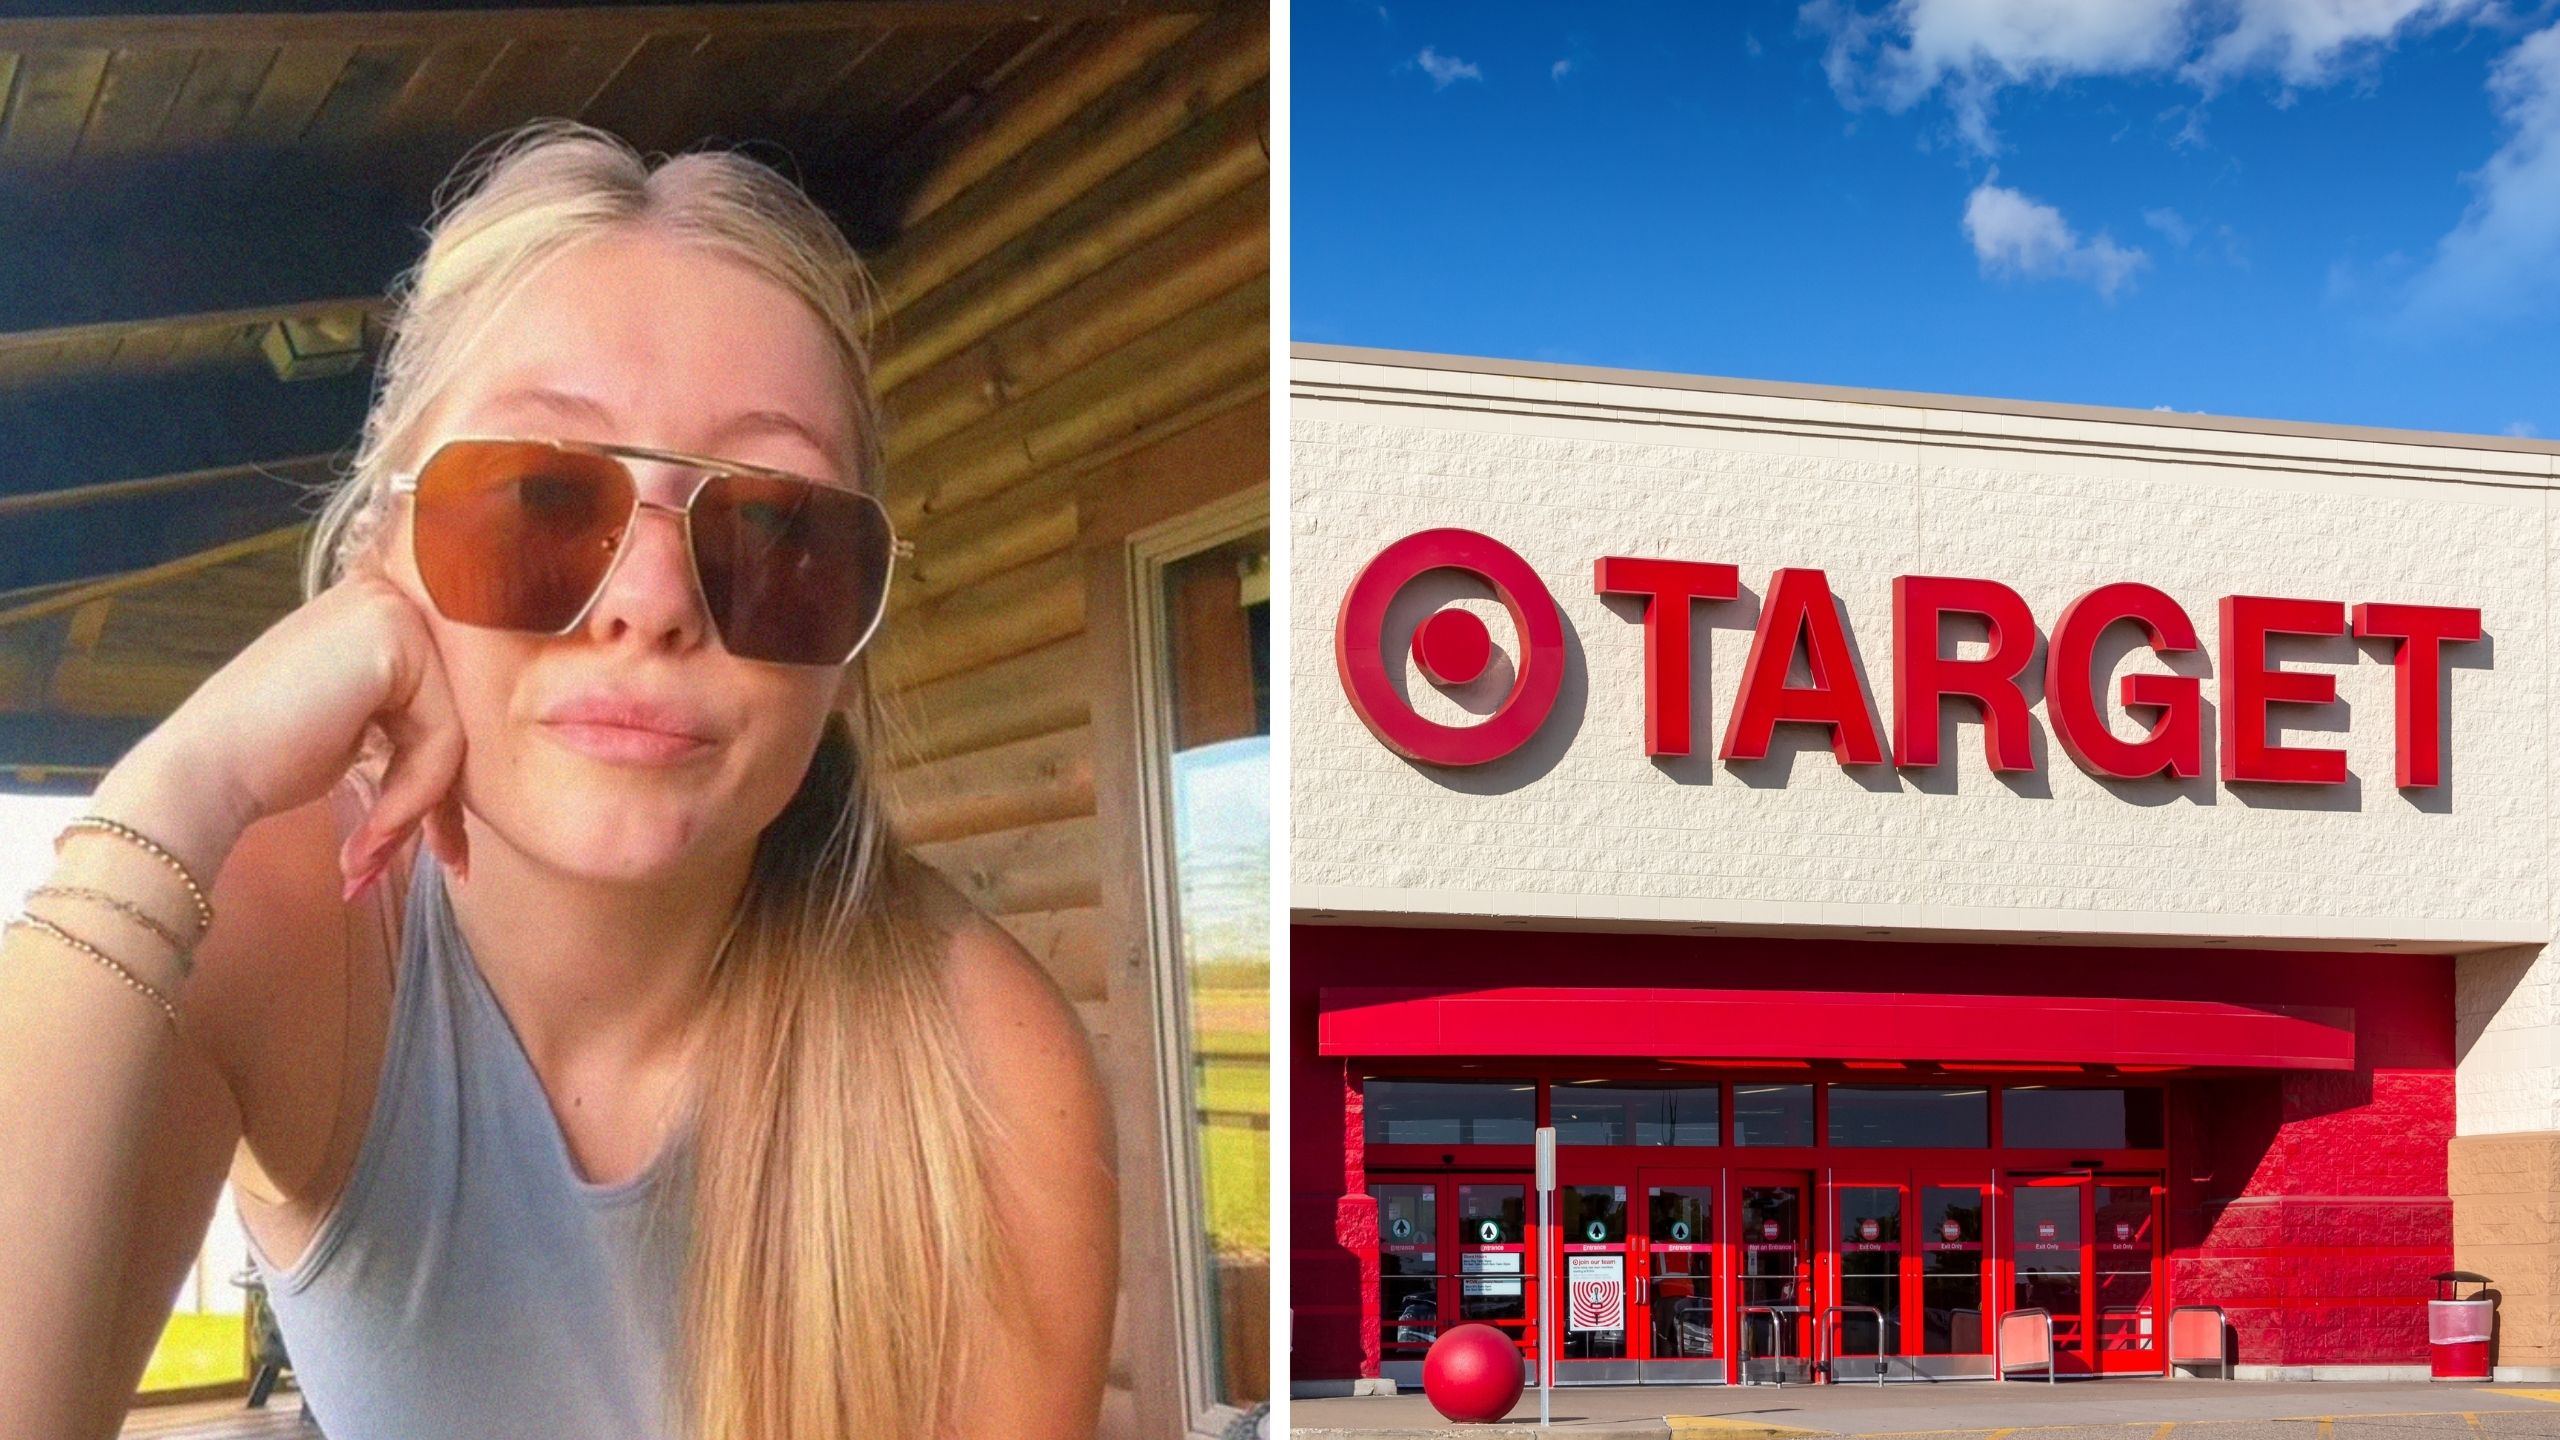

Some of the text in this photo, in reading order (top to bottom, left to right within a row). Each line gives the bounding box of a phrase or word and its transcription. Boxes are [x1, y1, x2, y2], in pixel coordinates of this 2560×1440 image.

[1594, 555, 2482, 789] TARGET
[1768, 1243, 1792, 1251] Entrance
[1869, 1243, 1881, 1251] Only
